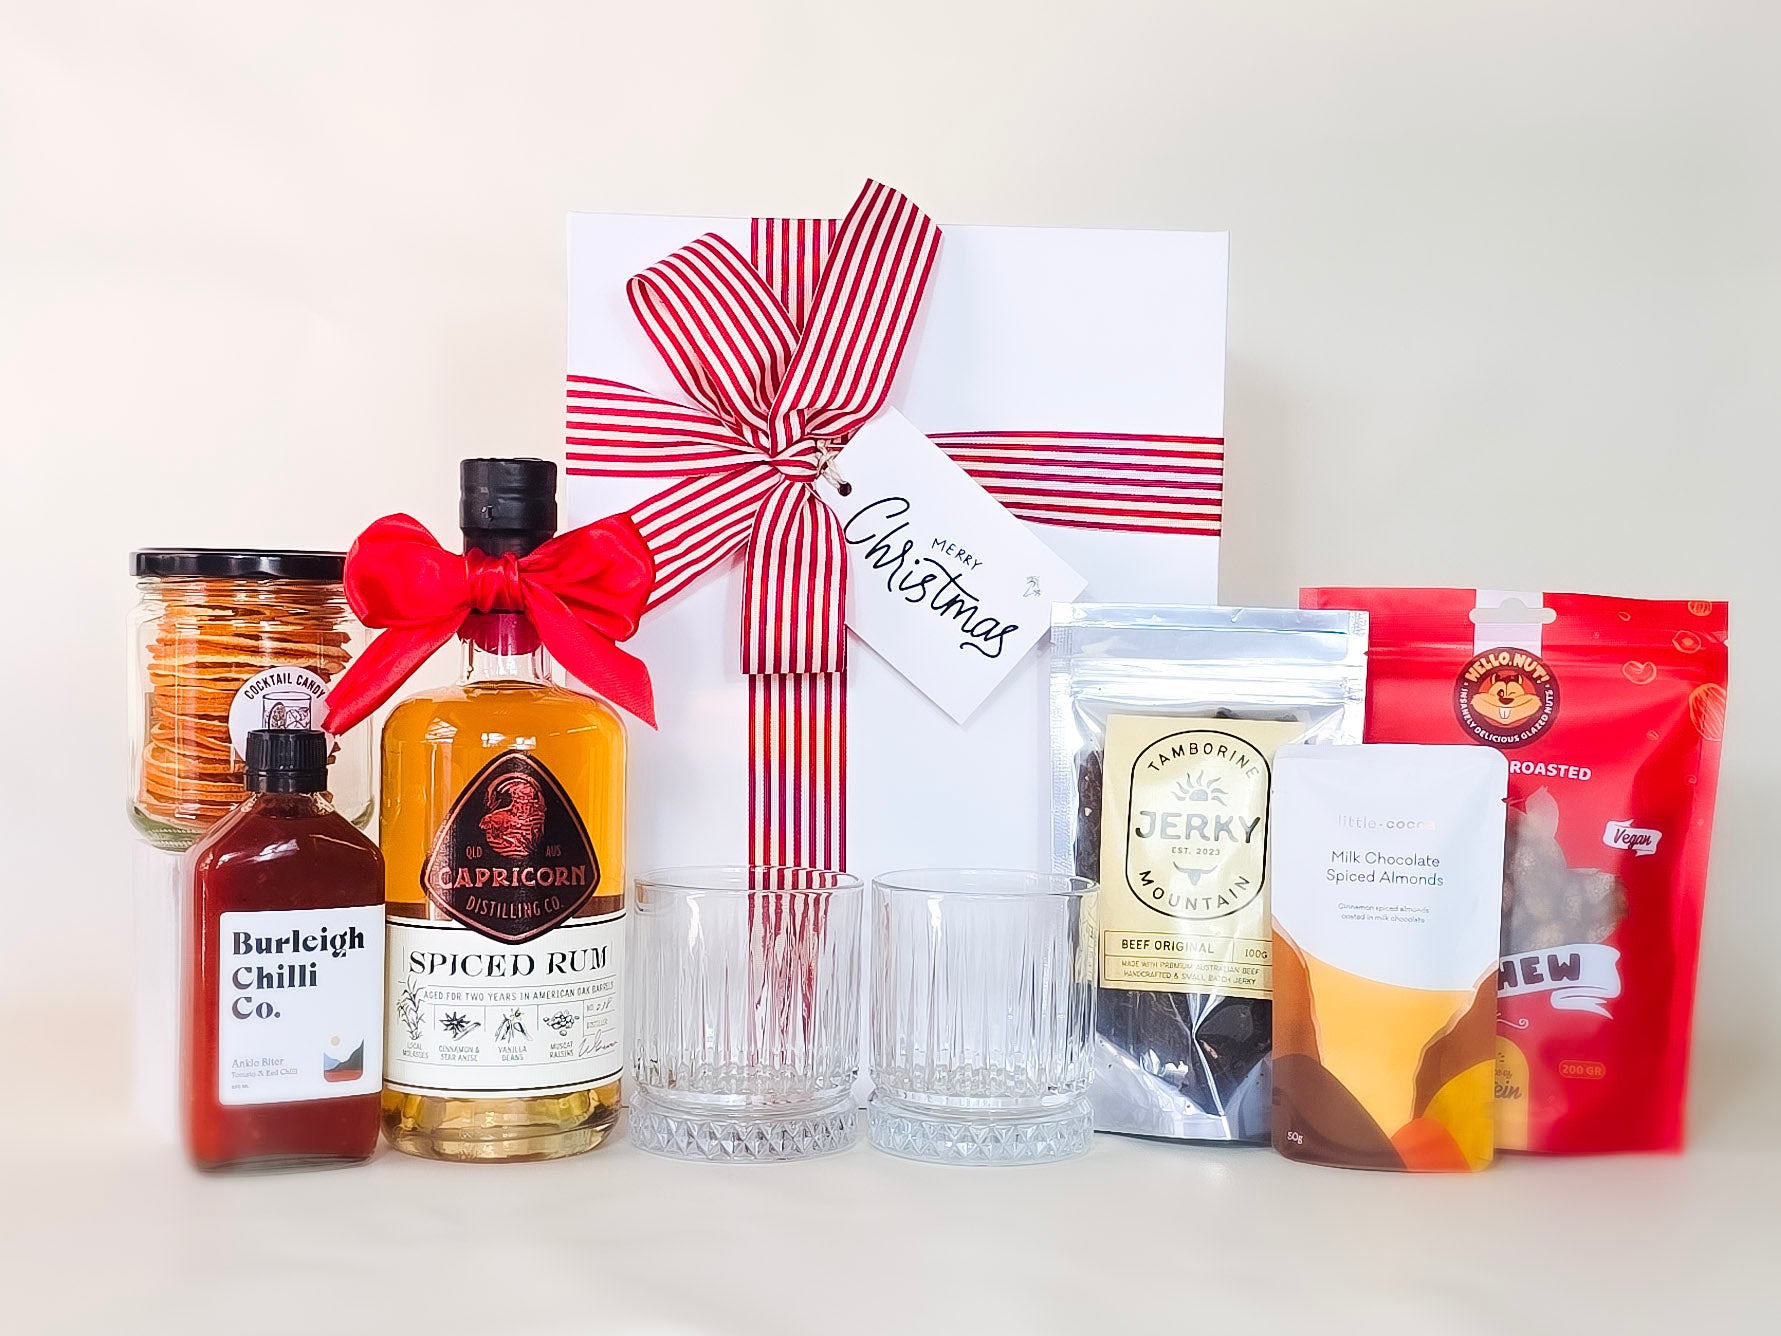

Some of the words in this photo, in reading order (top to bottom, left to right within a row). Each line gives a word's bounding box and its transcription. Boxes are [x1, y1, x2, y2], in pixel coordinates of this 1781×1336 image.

[931, 538, 983, 570] MERRY
[843, 497, 1019, 659] Christmas
[1513, 652, 1550, 684] NUT!
[244, 672, 292, 700] COCKTAIL
[296, 674, 326, 699] CANDY
[1459, 687, 1477, 728] INSANELY
[1473, 726, 1520, 743] DELICIOUS
[1520, 715, 1549, 740] GLAZED
[1544, 689, 1554, 714] NUTS
[1147, 742, 1260, 779] TAMBORINE
[1509, 760, 1592, 781] ROASTED
[1135, 810, 1261, 844] JERKY
[545, 844, 562, 857] AUS
[1613, 828, 1653, 850] Vegan
[465, 846, 482, 858] QLD
[1171, 846, 1192, 855] EST.
[1196, 847, 1220, 856] 2023
[1331, 850, 1360, 864] Milk
[1364, 851, 1440, 867] Chocolate
[438, 865, 587, 888] CAPRICORN
[1326, 868, 1375, 885] Spiced
[1379, 870, 1444, 887] Almonds
[1139, 870, 1251, 911] MOUNTAIN
[465, 895, 541, 919] DISTILLING
[544, 895, 564, 913] CO.
[232, 926, 365, 958] Burleigh
[1121, 939, 1150, 950] BEEF
[1154, 940, 1215, 954] ORIGINAL
[1245, 948, 1268, 959] 100G
[409, 950, 535, 978] SPICED
[546, 945, 608, 975] RUM
[232, 962, 318, 990] Chilli
[423, 990, 444, 999] AGED
[446, 992, 462, 1000] FOR
[465, 992, 484, 1001] TWO
[487, 992, 517, 1001] YEARS
[520, 992, 529, 1000] IN
[532, 989, 575, 1000] AMERICAN
[577, 986, 590, 995] OAK
[232, 996, 281, 1020] Co.
[498, 1045, 527, 1054] VANILLA
[1562, 1064, 1584, 1075] 200
[1586, 1066, 1602, 1076] GR
[1287, 1131, 1303, 1145] 50g
